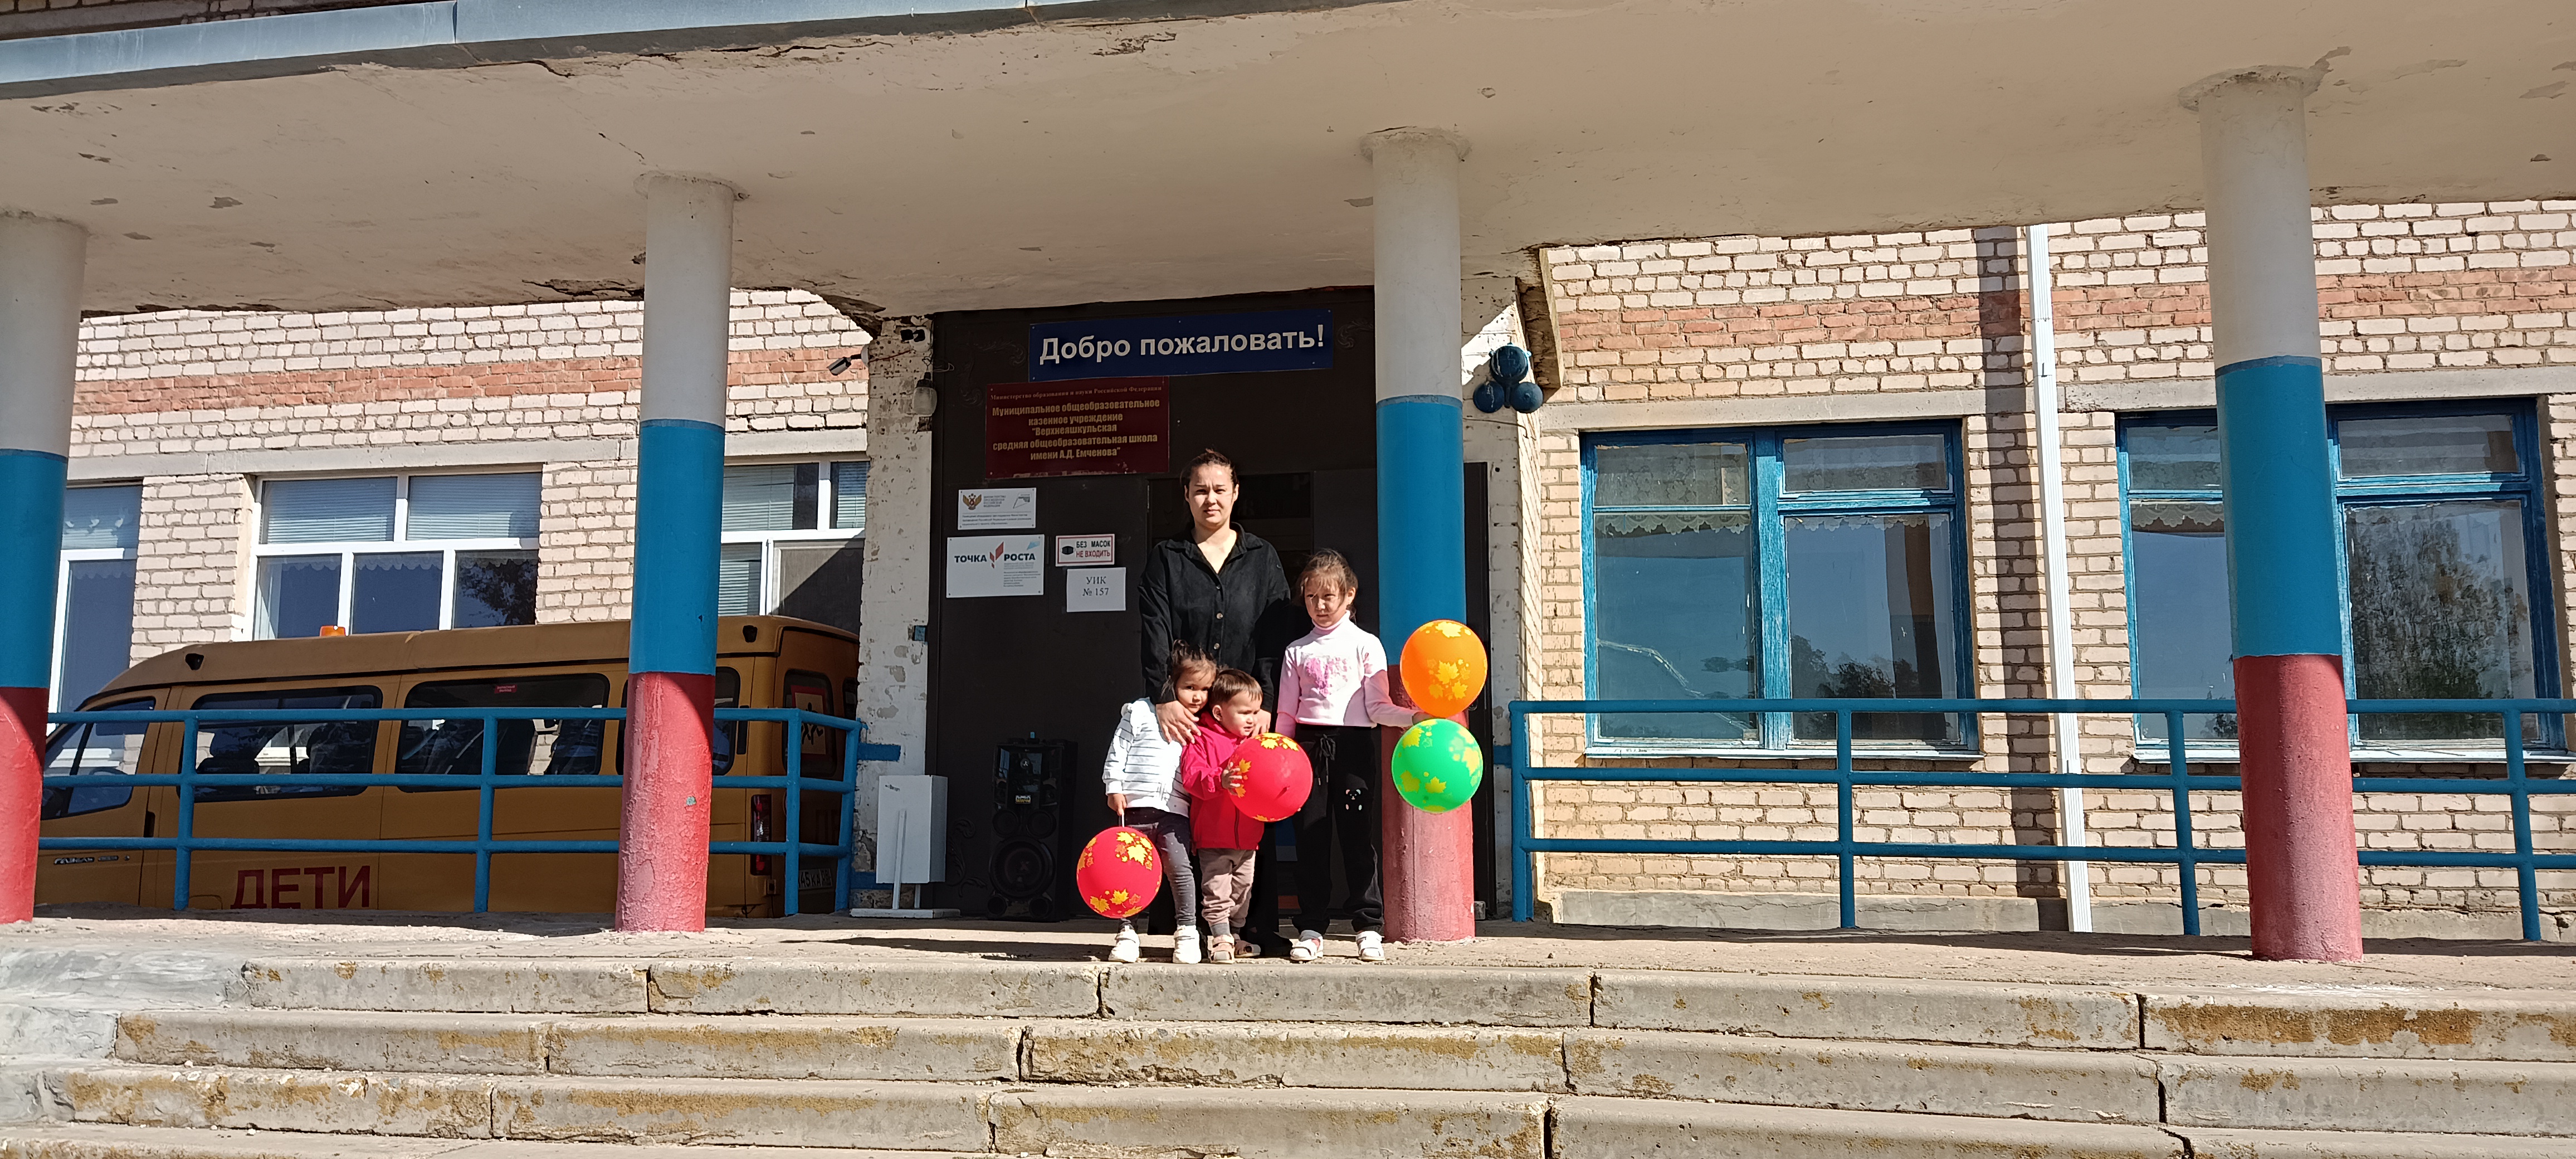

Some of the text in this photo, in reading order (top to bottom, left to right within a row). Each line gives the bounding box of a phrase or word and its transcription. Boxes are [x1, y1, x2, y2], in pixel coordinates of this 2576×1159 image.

[1040, 324, 1324, 365] Добро пожаловать!
[992, 400, 1160, 417] Муниципальное общеобразовательное
[1028, 413, 1123, 426] казенное учреждение
[993, 435, 1158, 451] средняя общеобразовательная школа
[1031, 451, 1058, 460] имени
[1059, 449, 1074, 459] А.Д.
[954, 554, 987, 563] ТОЧКА
[1085, 550, 1110, 558] ВХОДИТЬ
[1086, 576, 1106, 585] УИК
[1082, 587, 1109, 596] № 157
[230, 865, 370, 909] ДЕТИ
